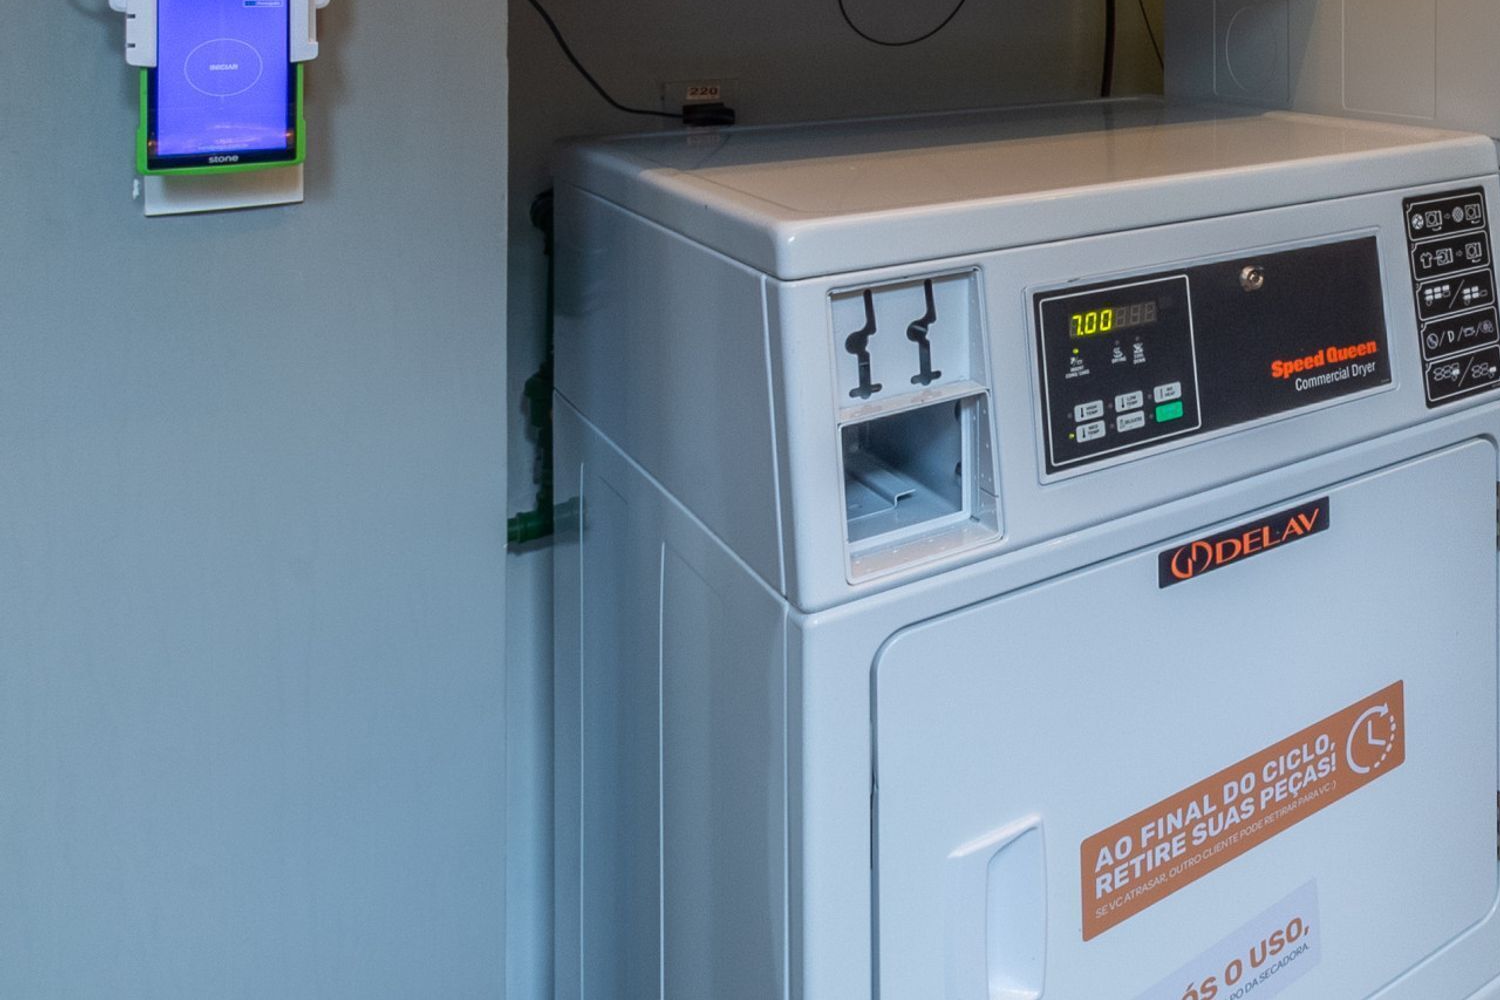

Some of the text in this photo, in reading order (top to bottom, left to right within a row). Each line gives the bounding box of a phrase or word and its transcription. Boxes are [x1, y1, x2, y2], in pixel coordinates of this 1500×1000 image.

[689, 87, 718, 96] 220
[208, 154, 239, 164] stone
[1072, 308, 1112, 336] 7.00
[1271, 340, 1377, 379] Speed Queen
[1295, 361, 1376, 392] Commercial Dryer
[1215, 507, 1320, 565] DELAV
[1095, 734, 1336, 873] AO FINAL DO CICLO,
[1095, 752, 1336, 900] RETIRE SUAS PEÇAS!
[1095, 904, 1109, 919] SE
[1109, 897, 1123, 911] VC
[1123, 873, 1168, 902] ATRASAR,
[1168, 855, 1202, 878] OUTRO
[1201, 832, 1239, 860] CLIENTE
[1239, 819, 1263, 840] PODE
[1263, 802, 1297, 825] RETIRAR
[1224, 958, 1243, 986] O
[1249, 917, 1310, 969] USO,
[1244, 978, 1258, 993] DA
